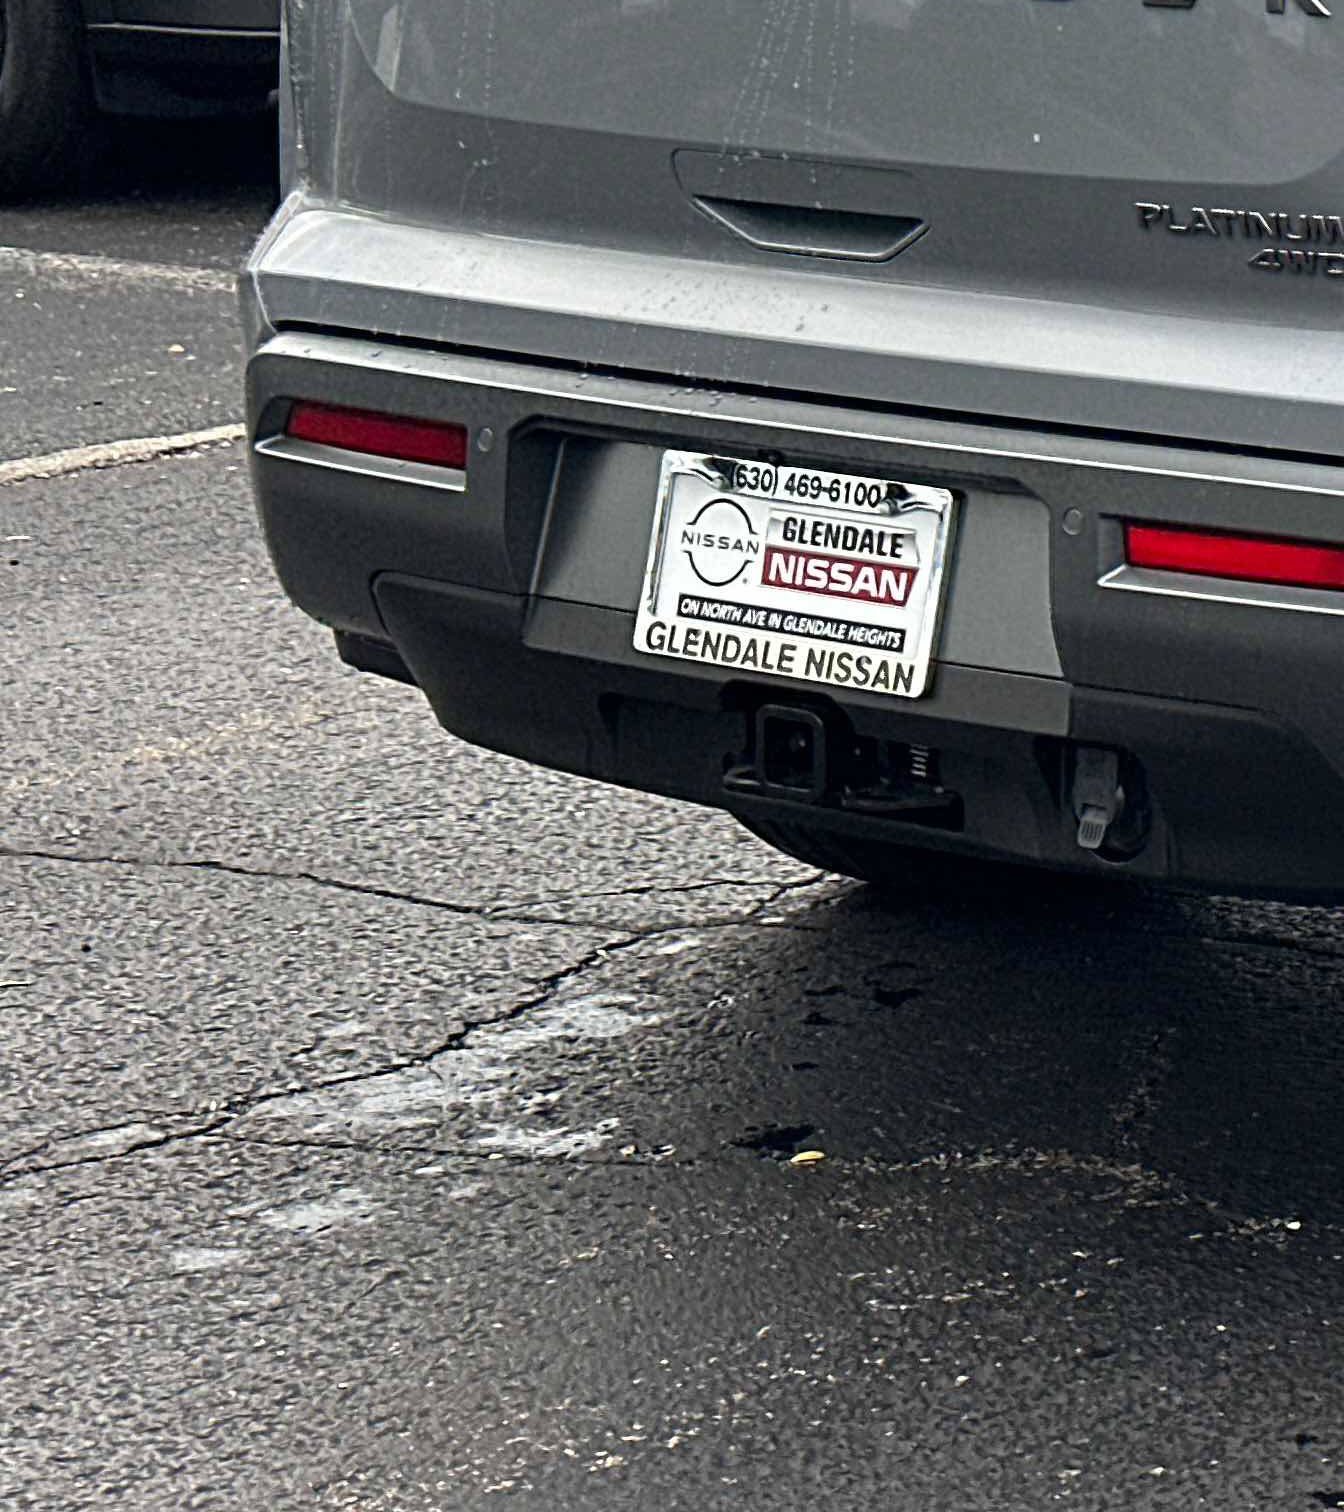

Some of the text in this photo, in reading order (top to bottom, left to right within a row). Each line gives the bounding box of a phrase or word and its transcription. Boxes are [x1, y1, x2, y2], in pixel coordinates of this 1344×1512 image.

[732, 465, 881, 509] (630) 469-6100
[681, 528, 760, 555] NISSAN
[782, 516, 904, 559] GLENDALE
[768, 552, 908, 602] NISSAN
[680, 598, 903, 649] ON NORTH AVE IN GLENDALE HEIGHTS
[646, 620, 916, 694] GLENDALE NISSAN
